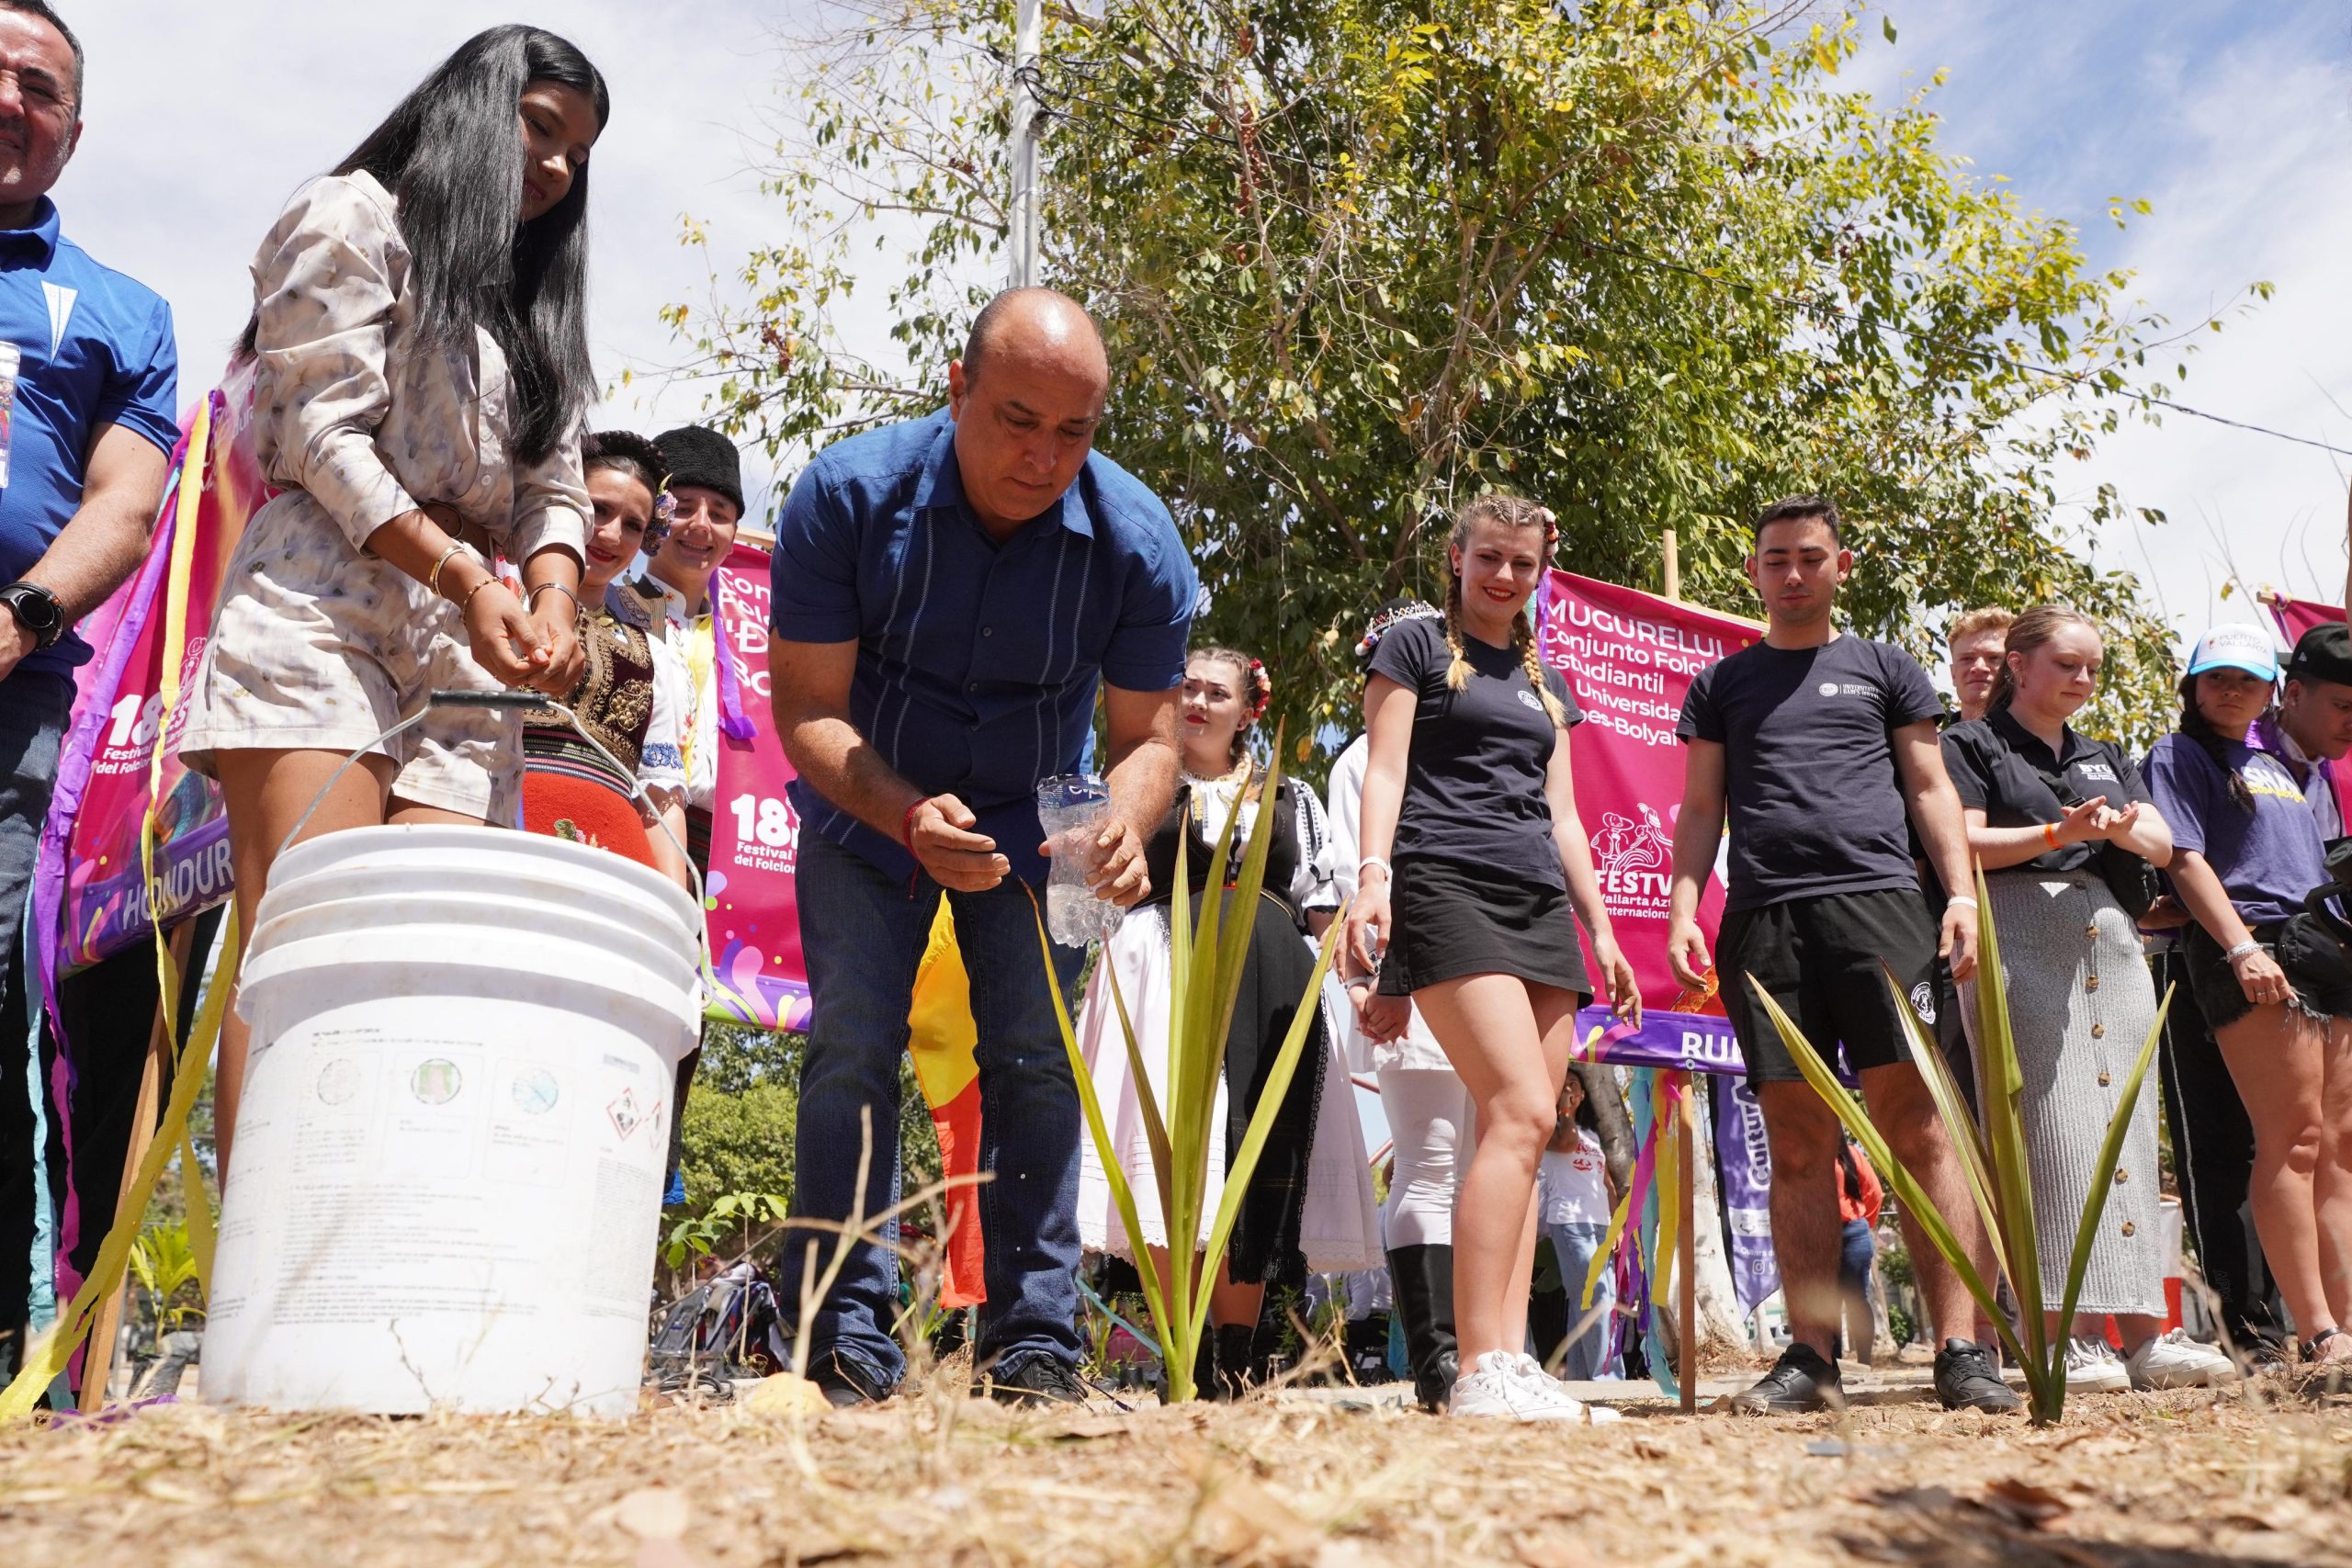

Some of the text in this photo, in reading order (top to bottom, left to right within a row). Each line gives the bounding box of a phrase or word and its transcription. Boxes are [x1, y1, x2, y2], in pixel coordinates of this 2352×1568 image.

[1539, 624, 1649, 665] Conjunto
[1546, 649, 1664, 694] Estudiantil
[103, 741, 153, 761] Festival
[96, 761, 118, 774] del
[730, 794, 791, 847] 18
[734, 853, 753, 867] del
[737, 840, 793, 861] Festival
